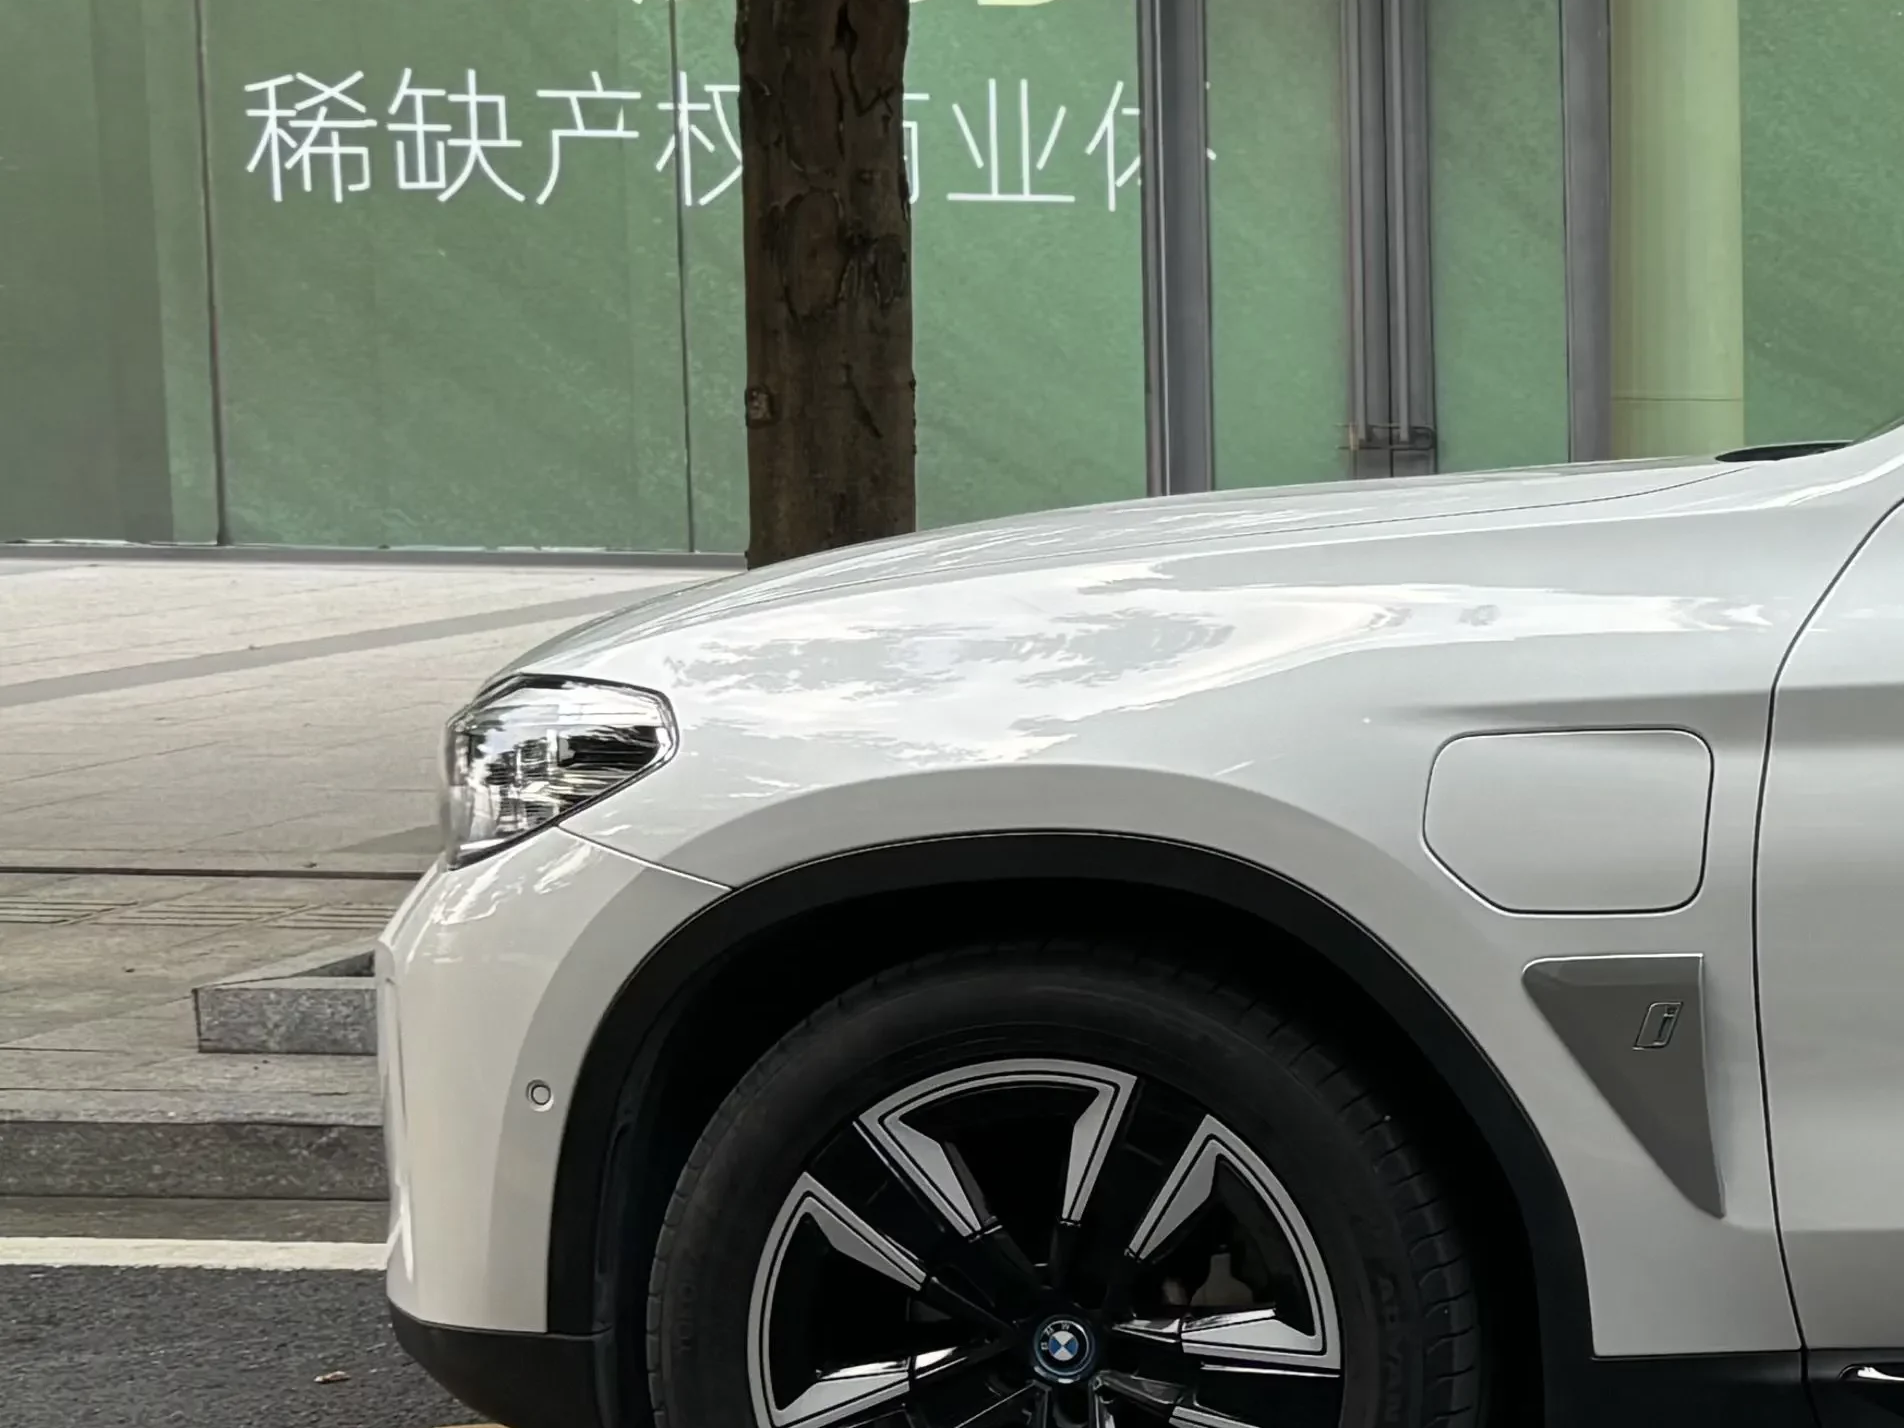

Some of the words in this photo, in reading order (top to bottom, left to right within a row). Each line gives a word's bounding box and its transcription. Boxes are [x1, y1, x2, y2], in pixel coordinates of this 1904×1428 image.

[243, 68, 1142, 212] 稀缺产权业
